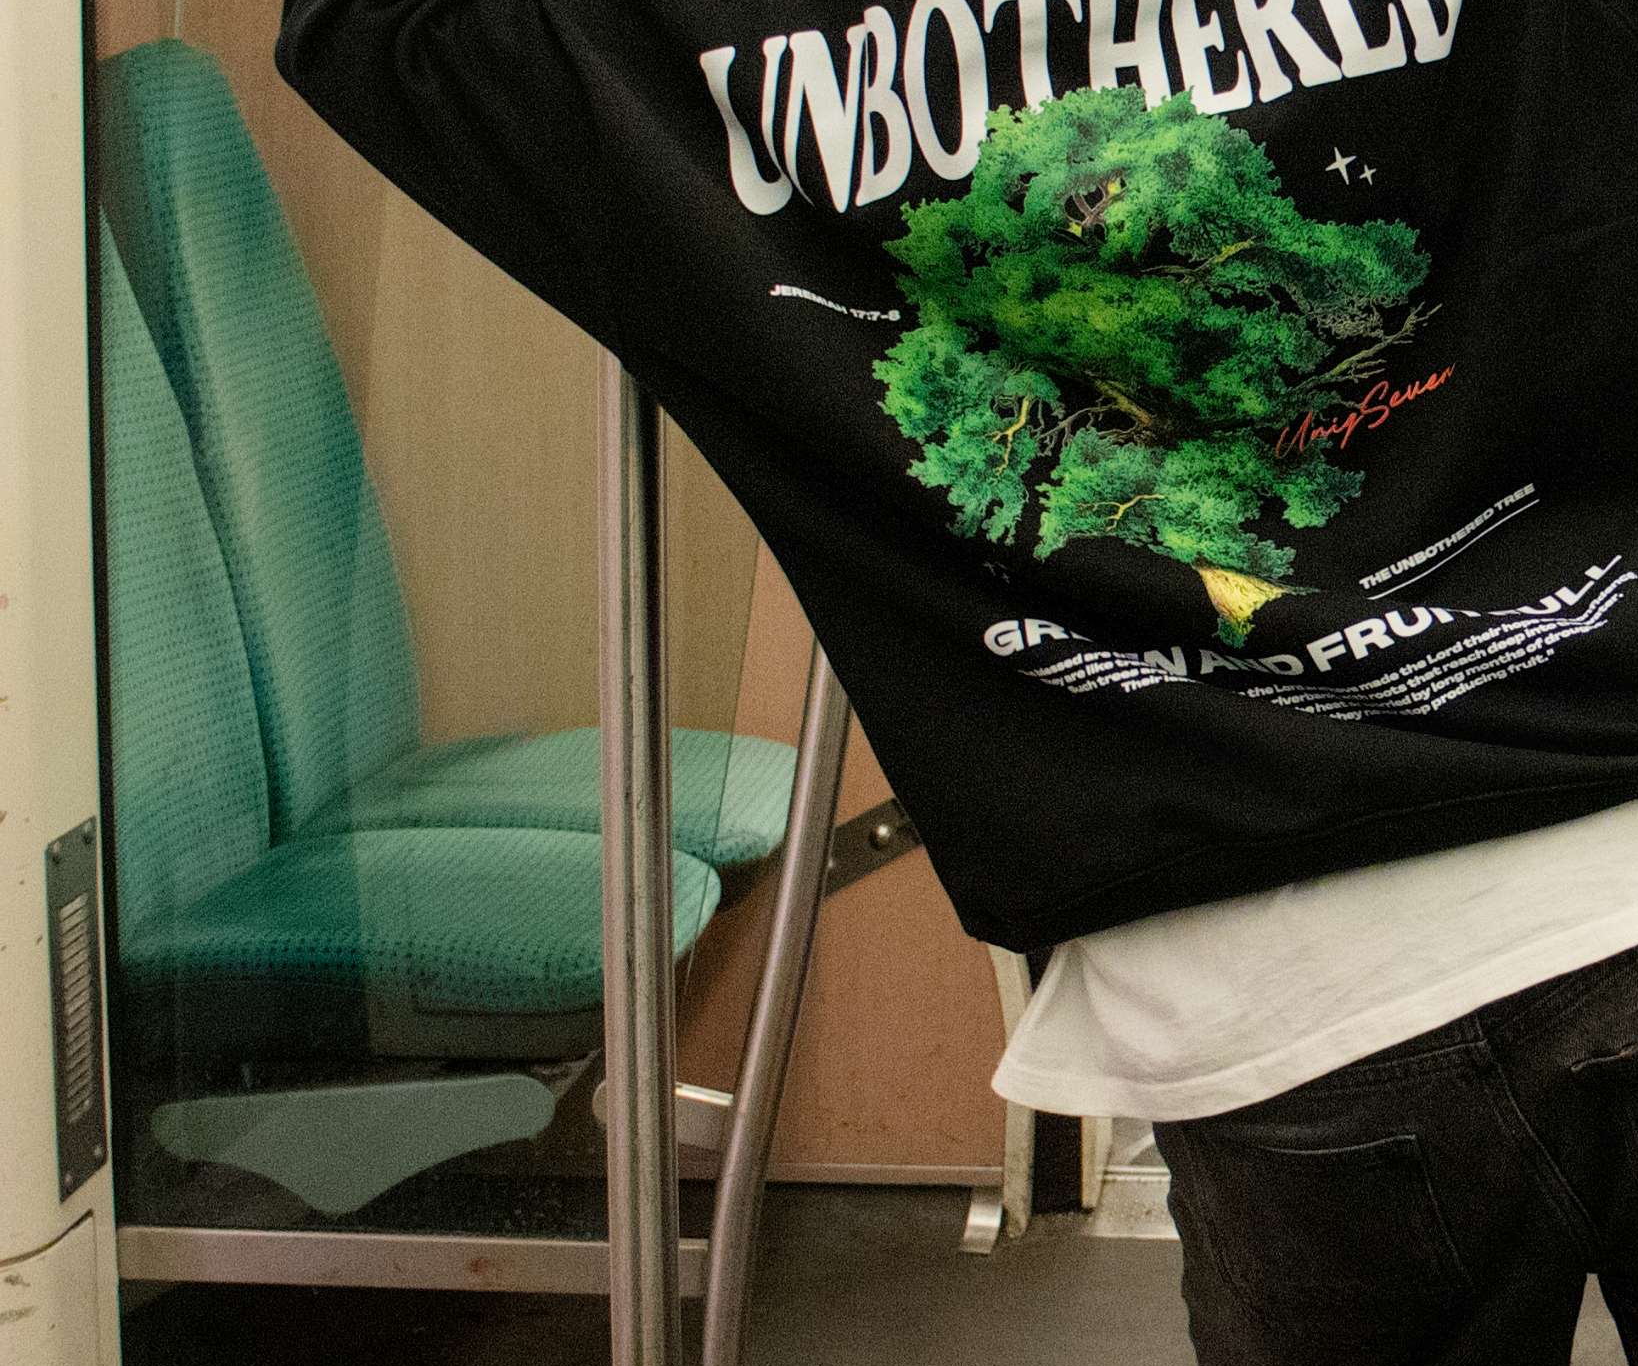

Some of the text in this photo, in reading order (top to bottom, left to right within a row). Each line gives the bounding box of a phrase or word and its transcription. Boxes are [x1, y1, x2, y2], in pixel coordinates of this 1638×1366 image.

[769, 284, 848, 315] JEREMIAH
[1358, 482, 1537, 590] THE UNBOTHERED TREE
[1199, 649, 1305, 677] AND
[1358, 672, 1400, 691] made
[1399, 660, 1428, 677] the
[1426, 641, 1464, 665] Lord
[1462, 626, 1502, 649] their
[1367, 683, 1408, 700] roots
[1406, 666, 1443, 688] that
[1441, 648, 1488, 673] reach
[1486, 631, 1526, 655] deep
[1410, 686, 1431, 702] by
[1430, 671, 1466, 693] long
[1464, 647, 1527, 677] months
[1525, 636, 1544, 654] of
[1430, 668, 1509, 712] producing
